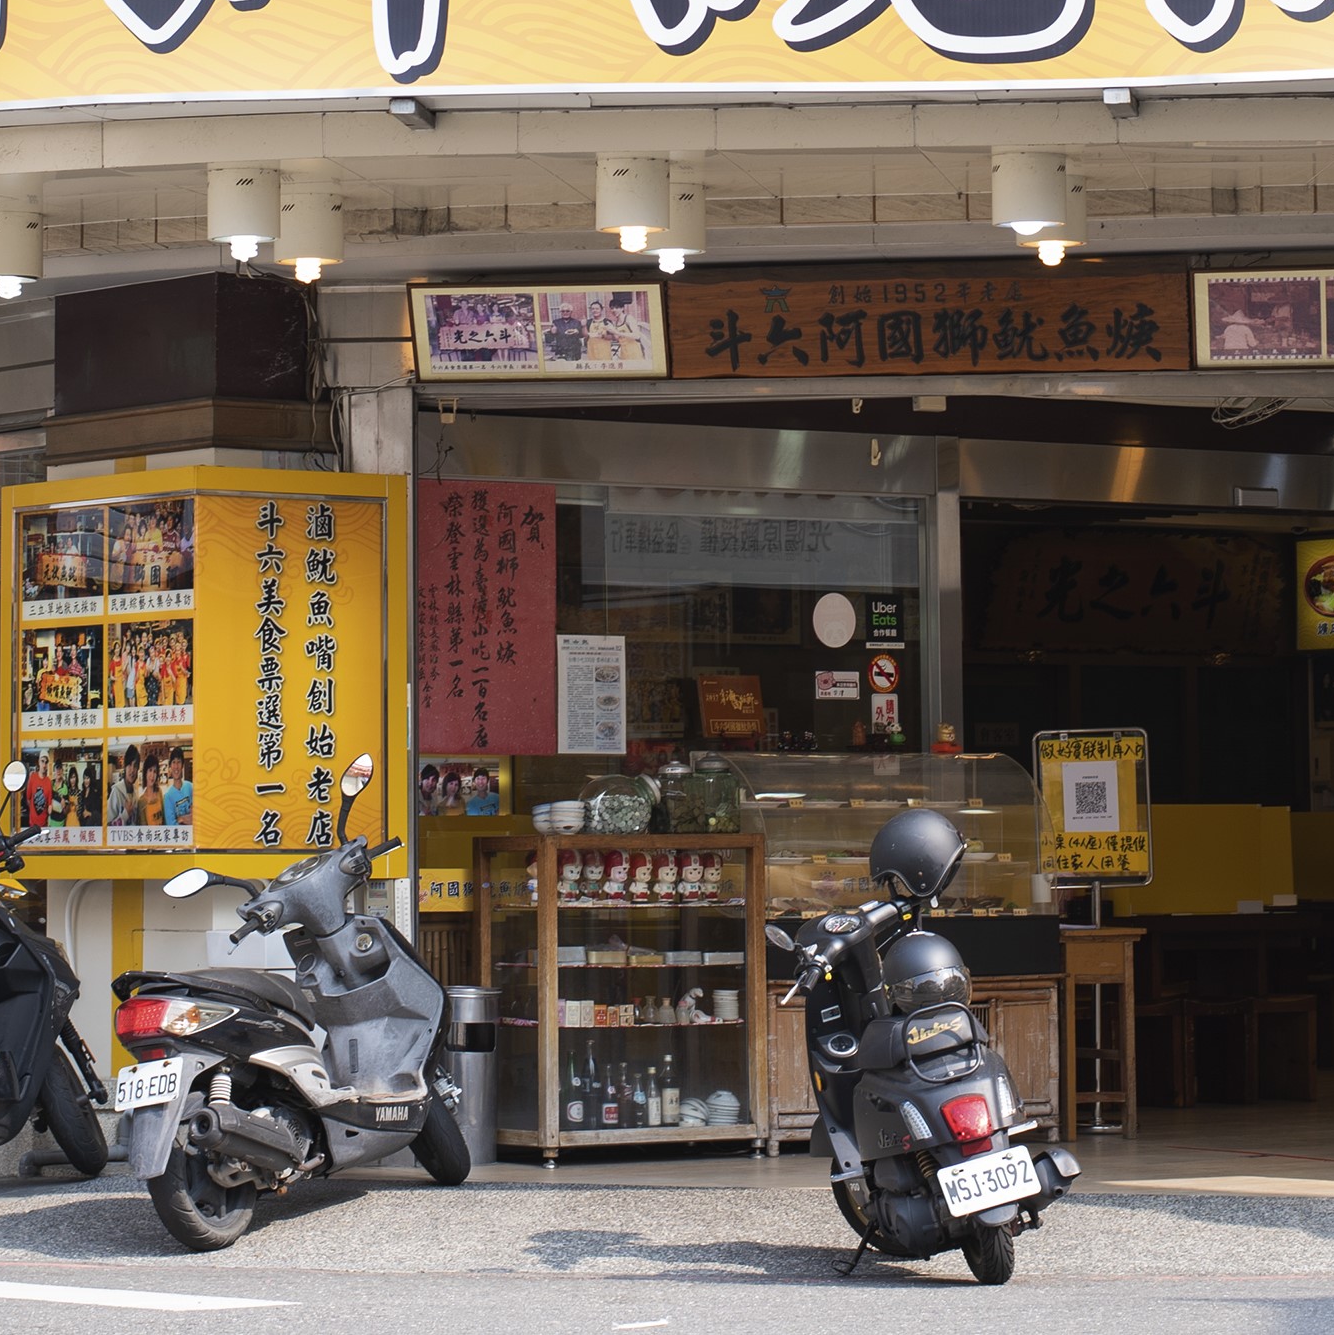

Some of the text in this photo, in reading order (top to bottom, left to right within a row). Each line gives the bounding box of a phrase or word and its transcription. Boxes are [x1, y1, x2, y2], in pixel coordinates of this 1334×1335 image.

[872, 601, 897, 614] Uber
[872, 614, 897, 626] Eats
[254, 500, 288, 847] 斗六美食票選第一名
[375, 1106, 409, 1122] YAMAHA
